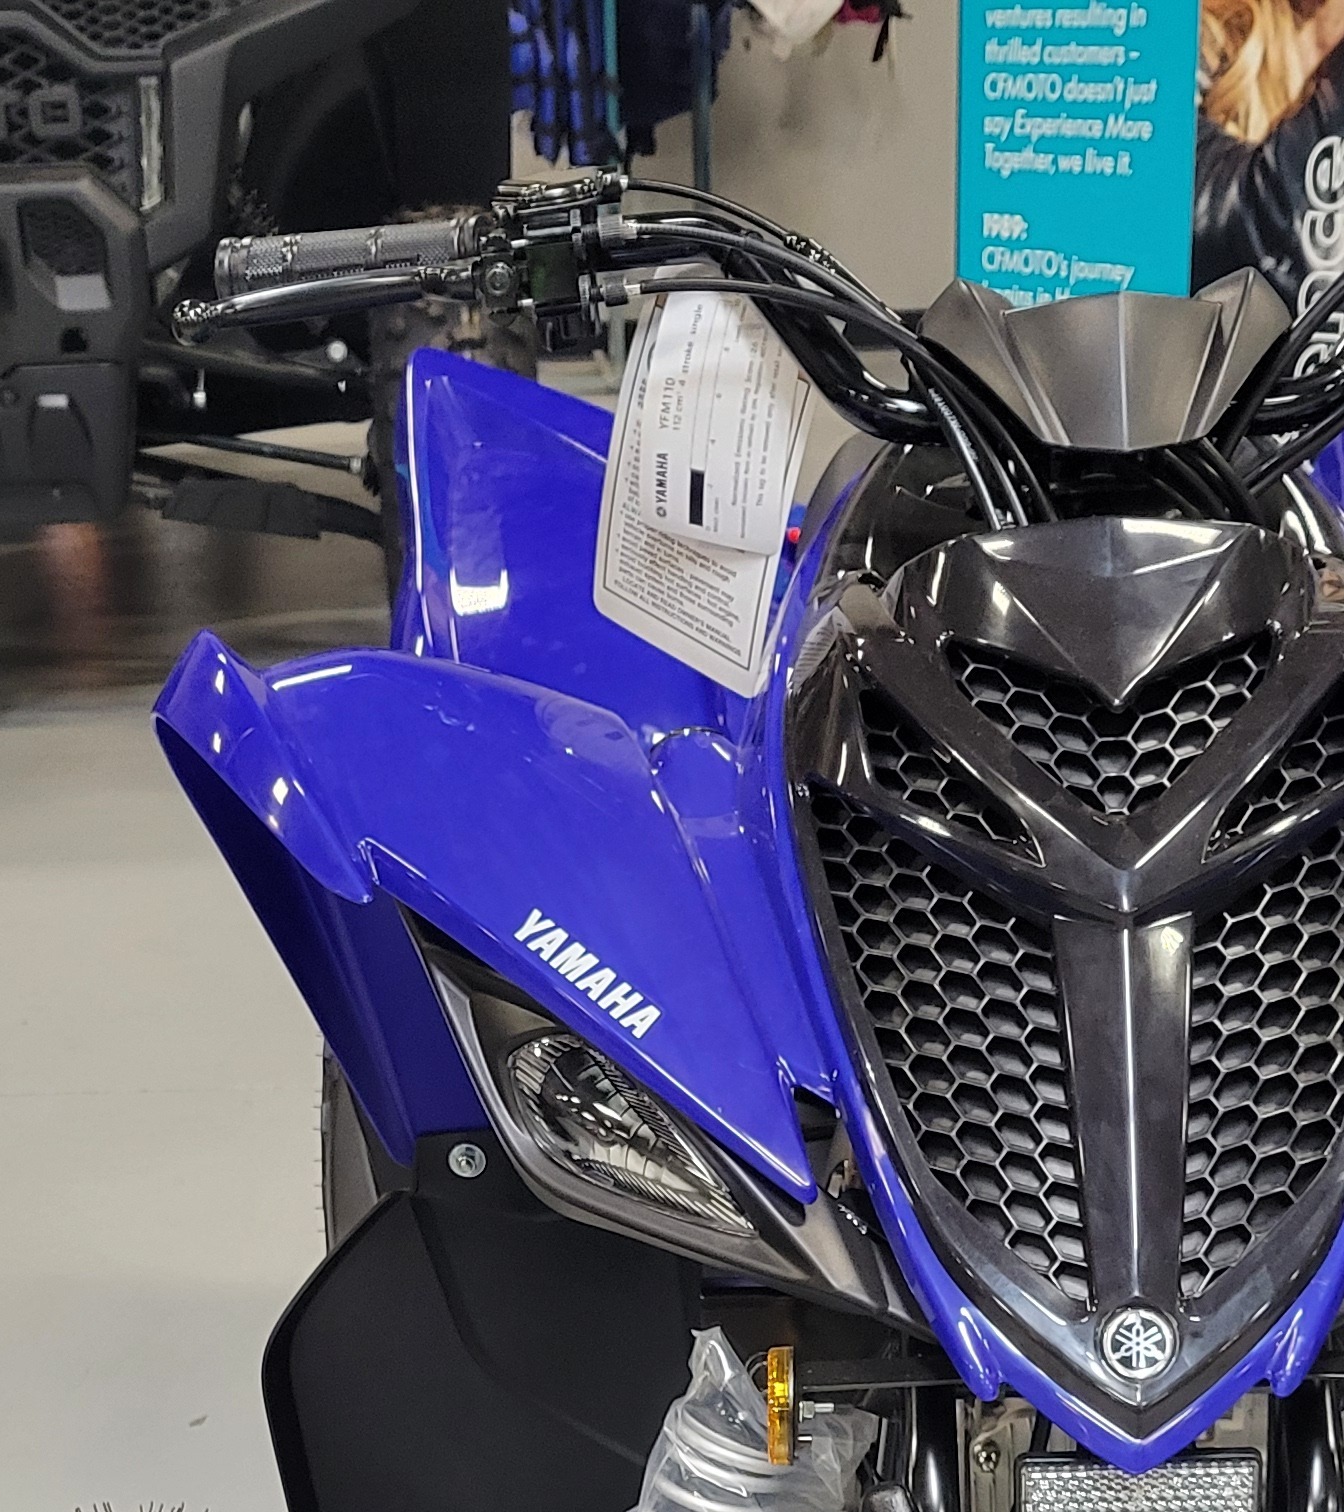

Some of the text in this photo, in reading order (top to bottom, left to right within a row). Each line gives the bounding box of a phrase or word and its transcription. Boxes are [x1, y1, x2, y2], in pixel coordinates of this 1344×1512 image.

[1129, 2, 1147, 28] in
[983, 72, 1063, 101] CFMOTO
[1124, 77, 1157, 112] just
[1013, 108, 1104, 142] Experience
[1105, 113, 1153, 141] More
[1058, 154, 1083, 175] we
[1084, 147, 1115, 176] live
[1069, 255, 1135, 291] journey
[655, 452, 670, 505] YAMAHA
[512, 908, 662, 1040] YAMAHA
